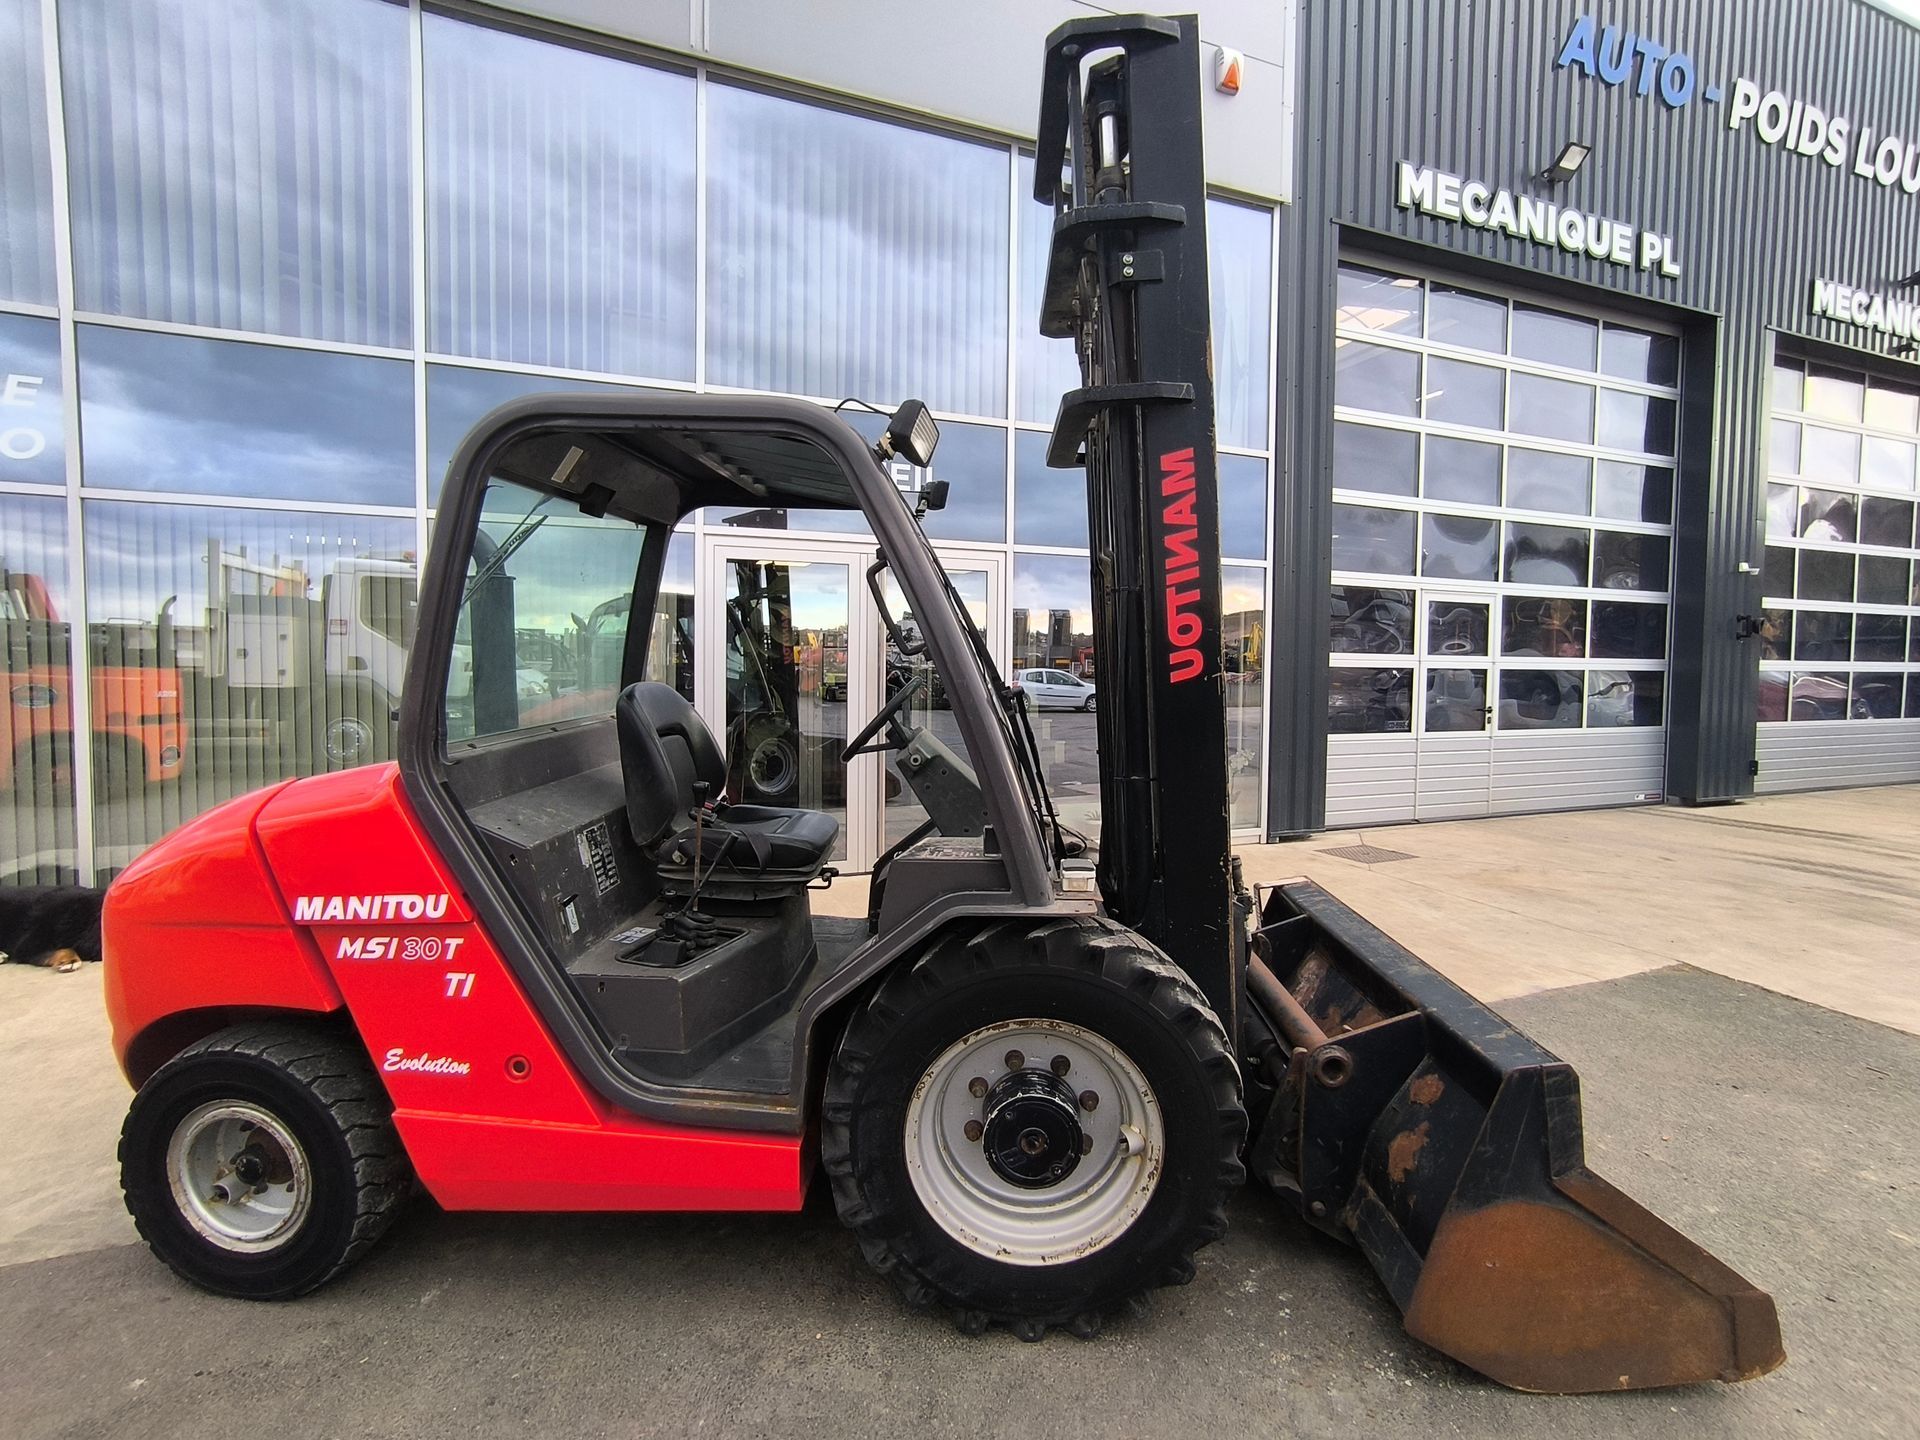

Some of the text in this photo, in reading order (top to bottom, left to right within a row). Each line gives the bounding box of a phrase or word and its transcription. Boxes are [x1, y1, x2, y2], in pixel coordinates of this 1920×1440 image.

[1558, 15, 1695, 108] AUTO
[1729, 77, 1850, 167] POIDS
[1854, 126, 1920, 194] LOU
[1398, 160, 1681, 276] MECANIQUE PL
[294, 893, 449, 921] MANITOU
[445, 972, 476, 997] TI
[383, 1048, 471, 1075] Evolution
